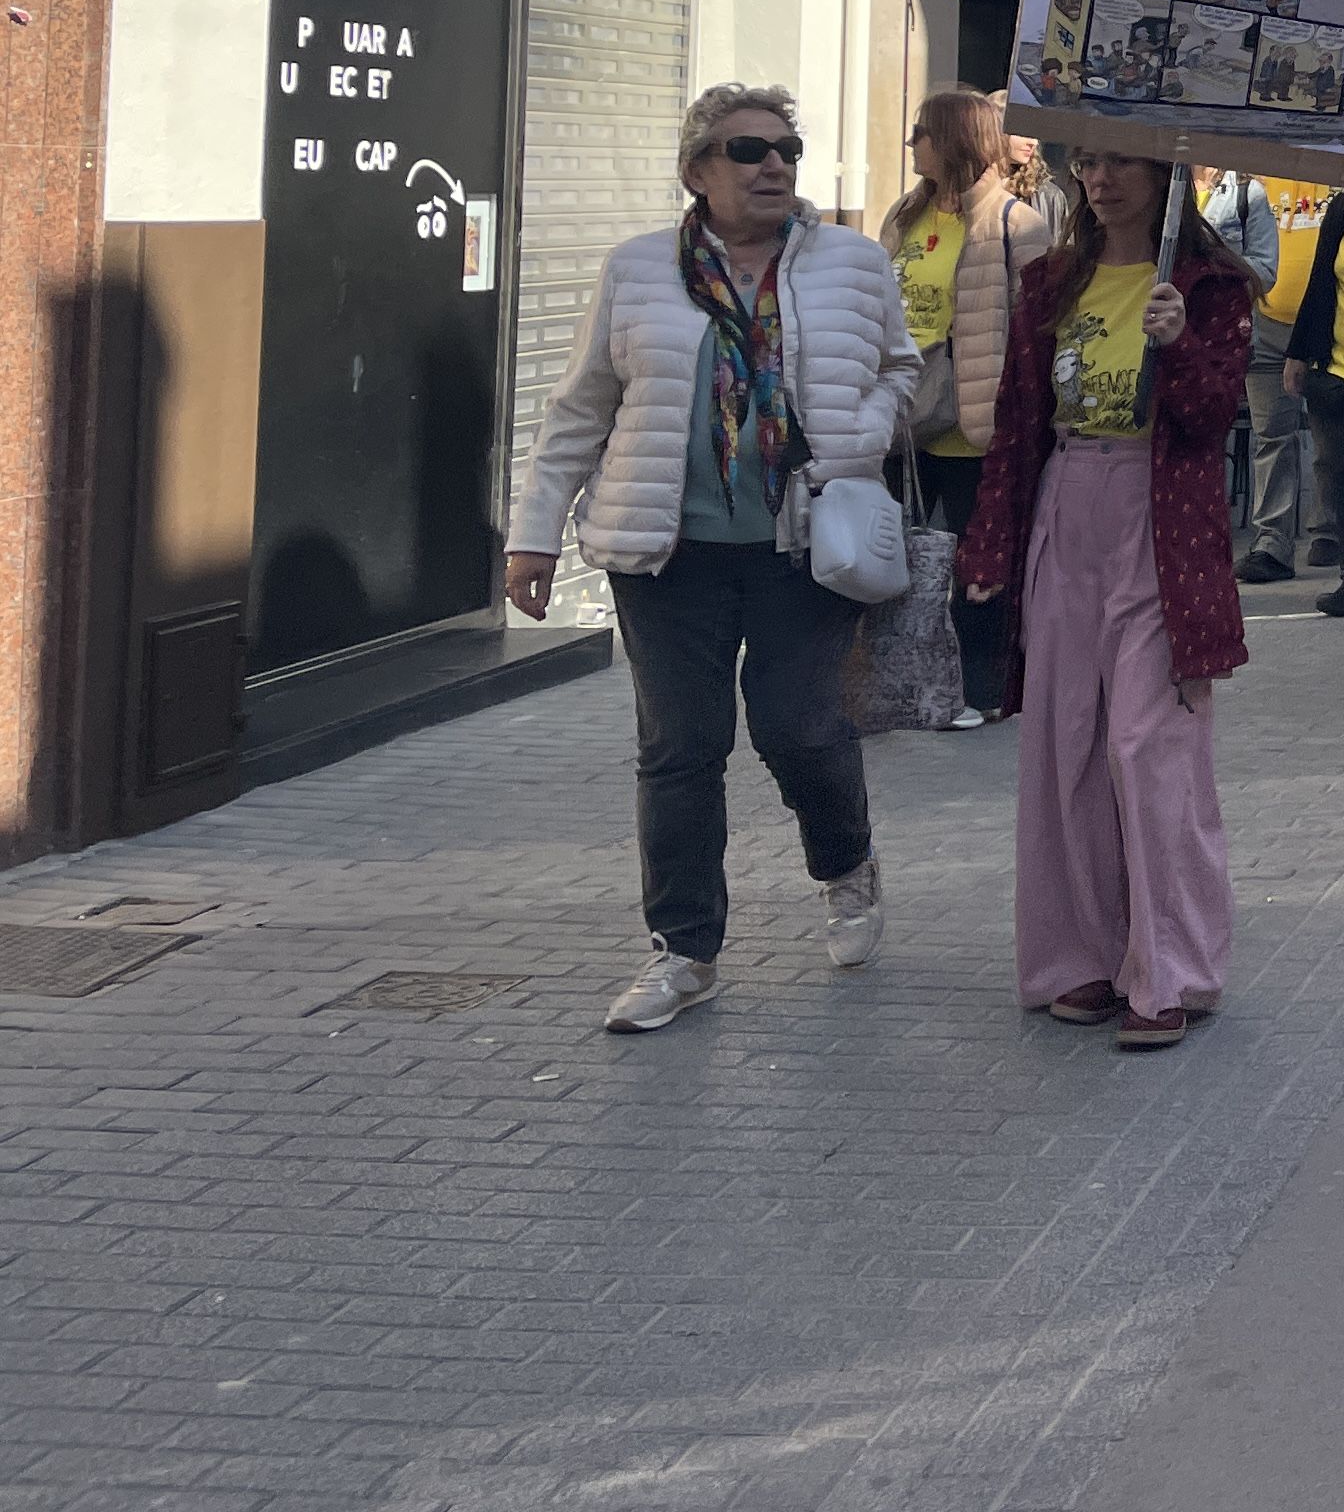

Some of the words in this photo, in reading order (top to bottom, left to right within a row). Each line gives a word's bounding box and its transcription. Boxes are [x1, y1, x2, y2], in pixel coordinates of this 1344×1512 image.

[298, 16, 314, 48] P
[343, 21, 387, 55] UAR
[396, 27, 414, 58] A
[280, 61, 298, 93] U
[293, 138, 325, 170] EU
[355, 140, 398, 171] CAP
